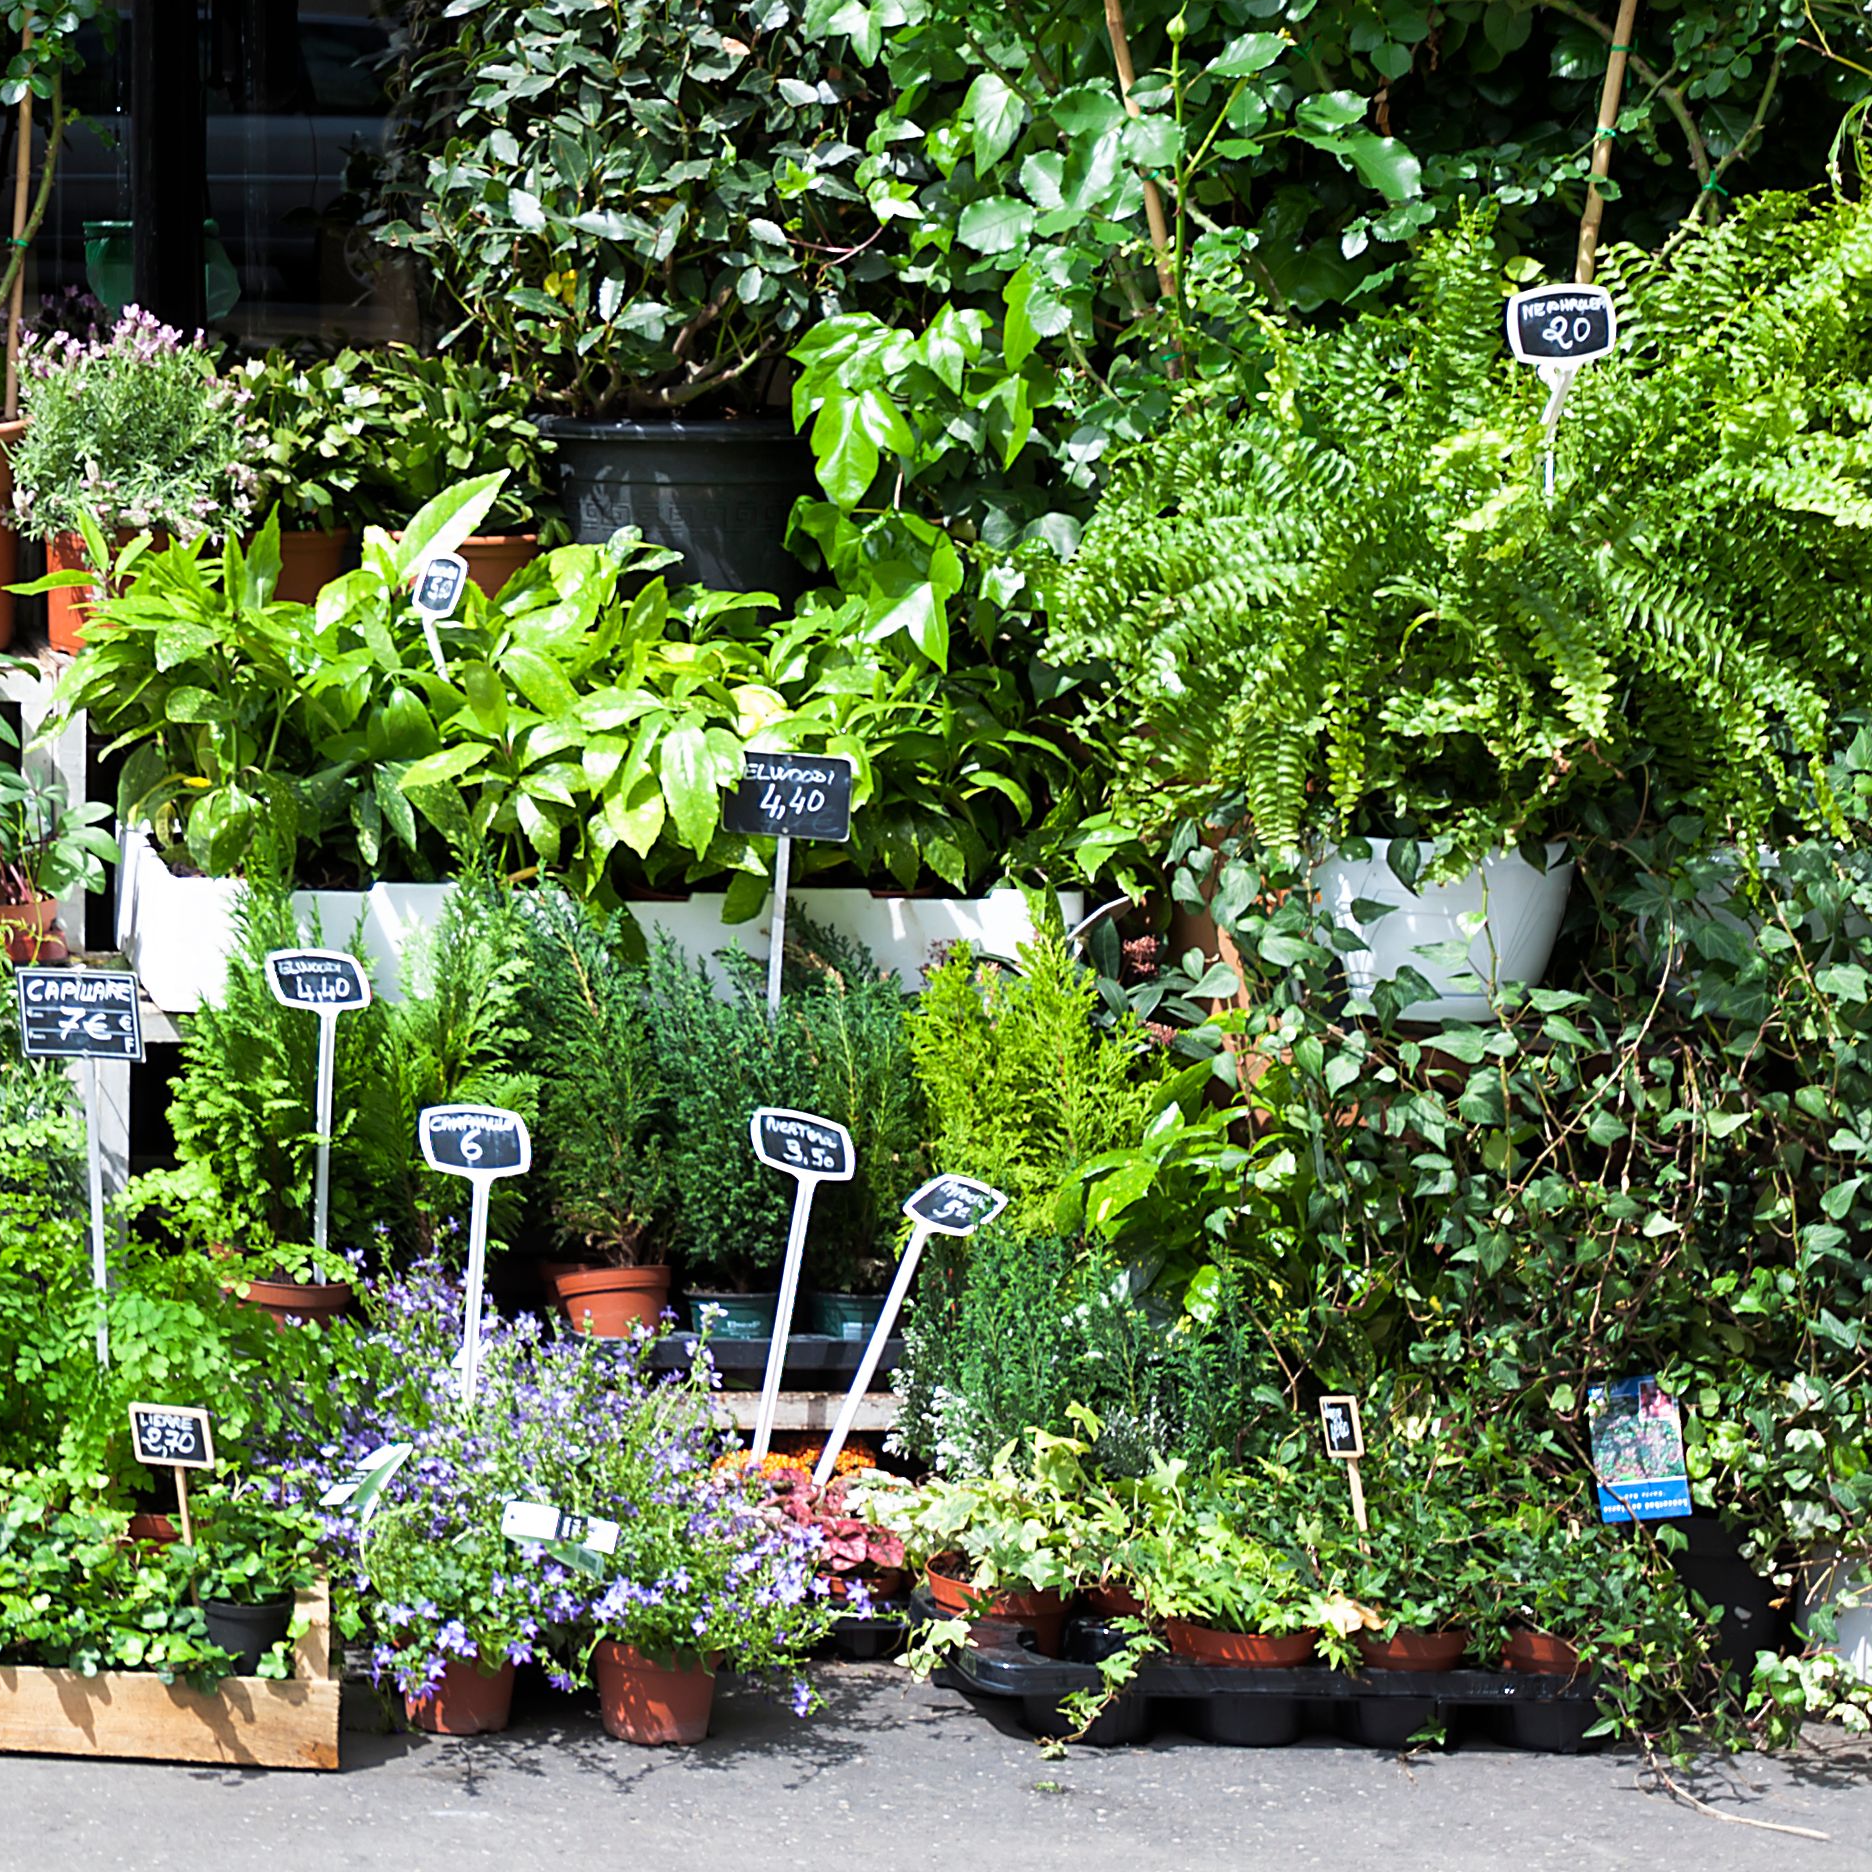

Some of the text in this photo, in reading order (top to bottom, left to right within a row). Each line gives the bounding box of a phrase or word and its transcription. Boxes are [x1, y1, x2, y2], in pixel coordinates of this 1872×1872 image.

[1542, 316, 1591, 349] 20
[760, 783, 825, 820] 4,40
[460, 1129, 483, 1161] 6
